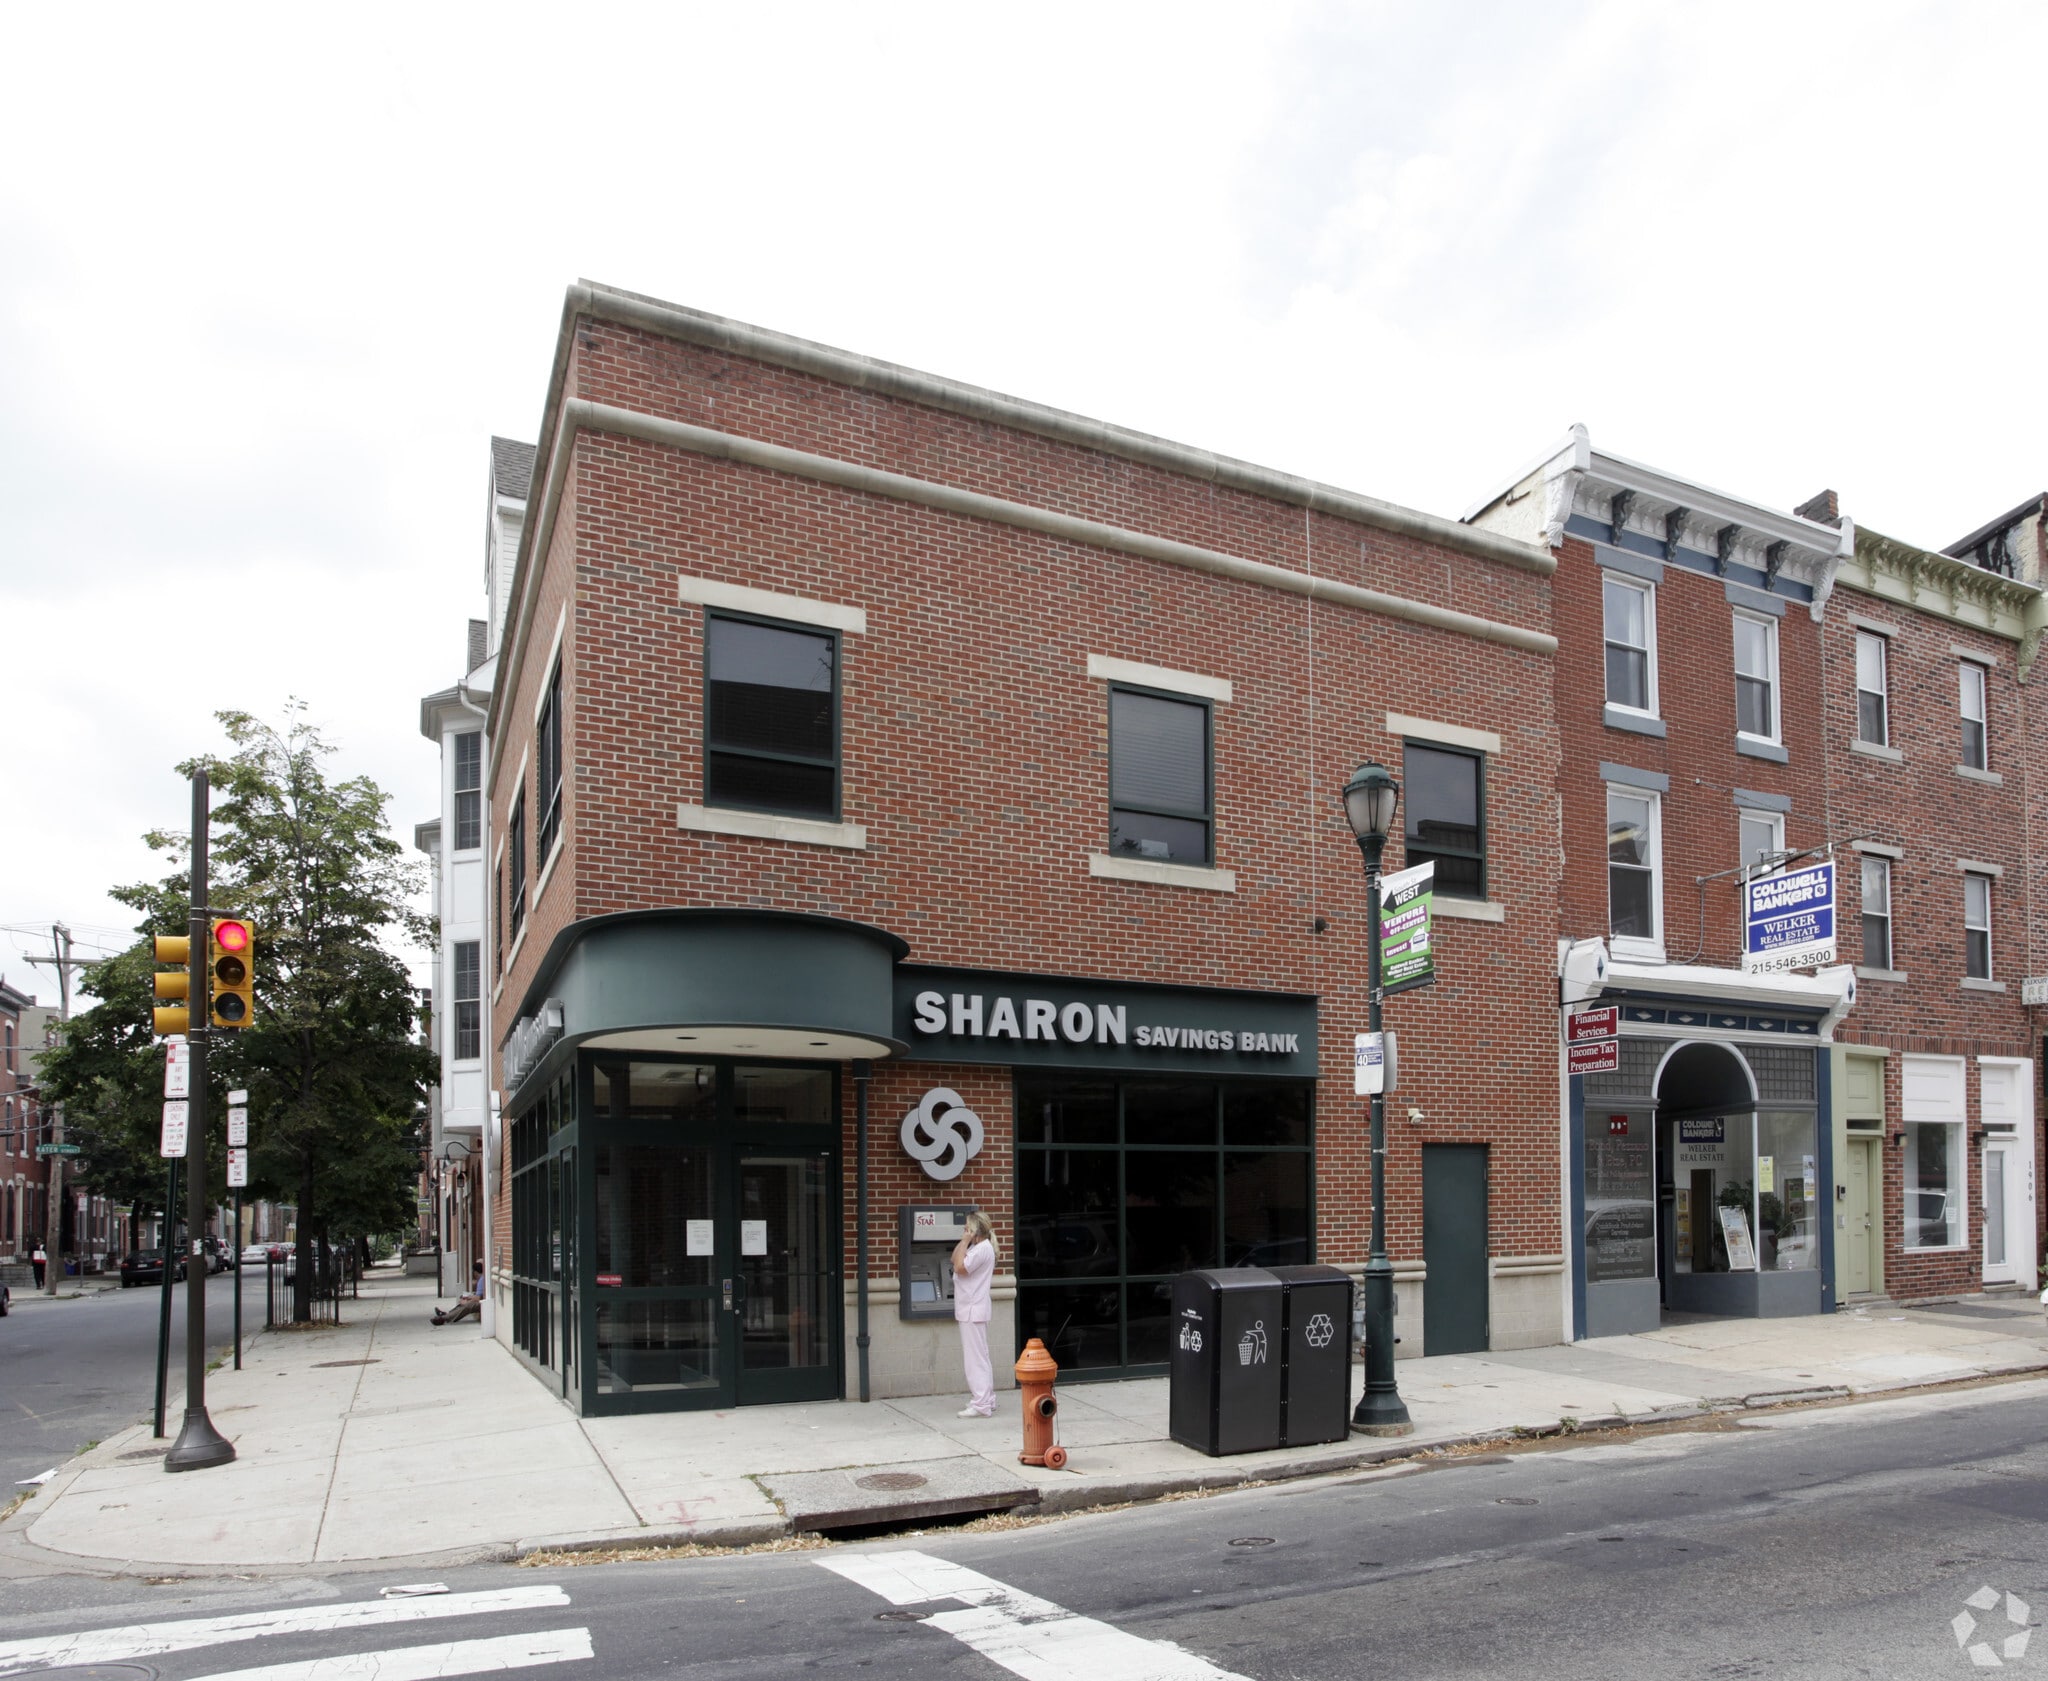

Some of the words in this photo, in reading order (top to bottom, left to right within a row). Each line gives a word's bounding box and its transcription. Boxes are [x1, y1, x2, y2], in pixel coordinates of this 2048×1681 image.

[1394, 884, 1420, 906] WEST
[1383, 905, 1425, 930] VENTURE
[1763, 914, 1816, 934] WELKER
[1760, 933, 1784, 946] REAL
[1785, 925, 1821, 939] ESTATE
[1751, 950, 1831, 974] 215-546-3500
[2028, 985, 2048, 997] RE
[914, 991, 1127, 1045] SHARON
[1575, 1009, 1610, 1024] Financial
[1576, 1025, 1608, 1038] Services
[1134, 1025, 1234, 1050] SAVINGS
[1238, 1030, 1299, 1053] BANK
[1570, 1048, 1598, 1058] Income
[1600, 1044, 1615, 1054] Tax
[1358, 1054, 1368, 1066] 40
[1570, 1058, 1615, 1072] Preparation
[1688, 1144, 1717, 1153] WELKER
[1679, 1153, 1697, 1162] REAL
[1699, 1153, 1725, 1162] ESTATE
[916, 1215, 935, 1226] STAR
